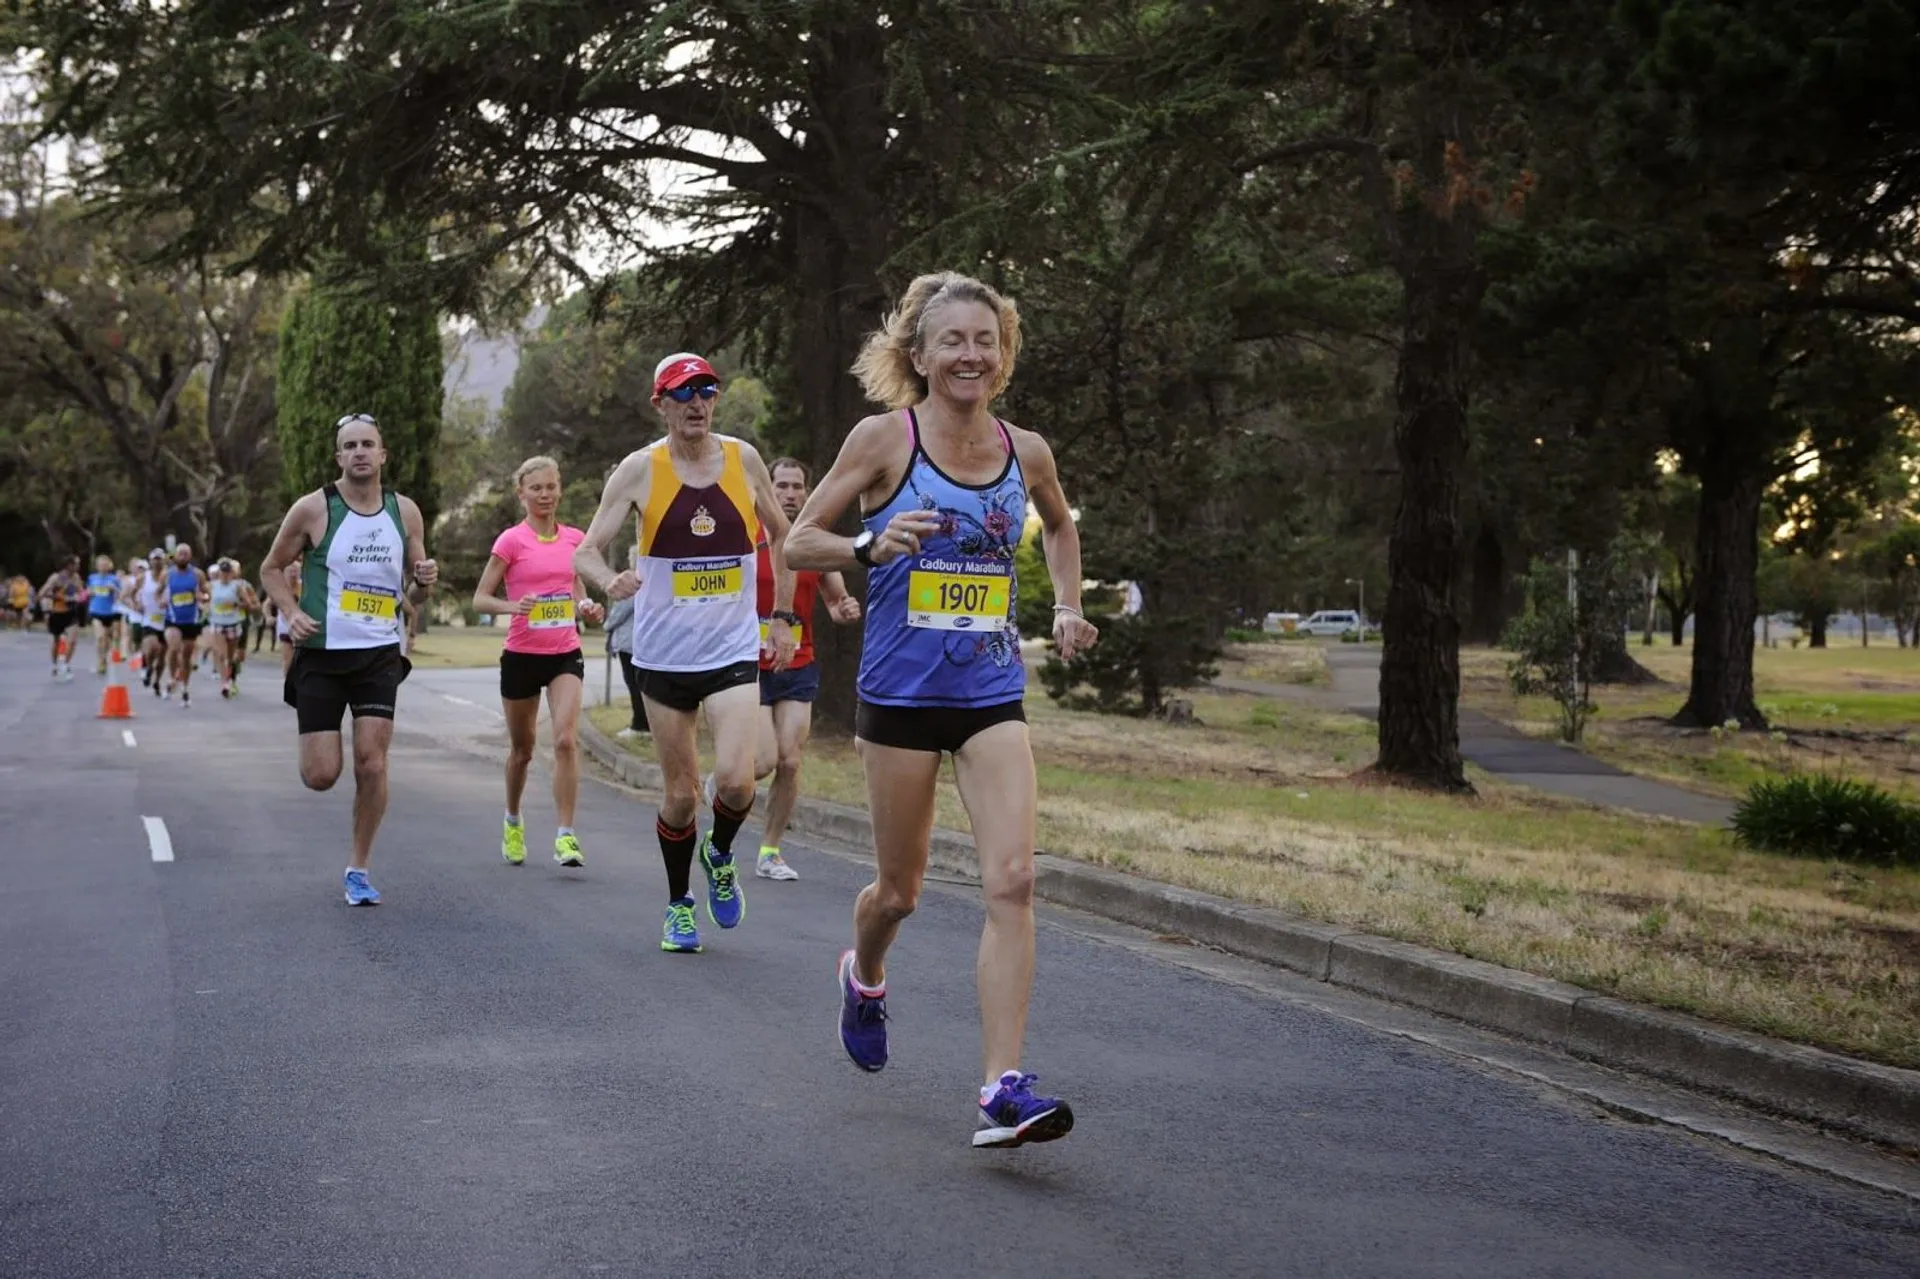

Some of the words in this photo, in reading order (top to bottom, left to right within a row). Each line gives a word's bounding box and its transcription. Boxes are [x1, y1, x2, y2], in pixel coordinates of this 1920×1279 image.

[351, 544, 391, 554] Sydney
[346, 555, 392, 563] Striders
[677, 562, 705, 572] Cadbury
[706, 560, 737, 570] Marathon
[919, 558, 963, 573] Cadbury
[965, 561, 1006, 575] Marathon
[690, 575, 726, 591] JOHN
[939, 583, 989, 611] 1907
[357, 597, 383, 615] 1537
[541, 605, 566, 619] 1698
